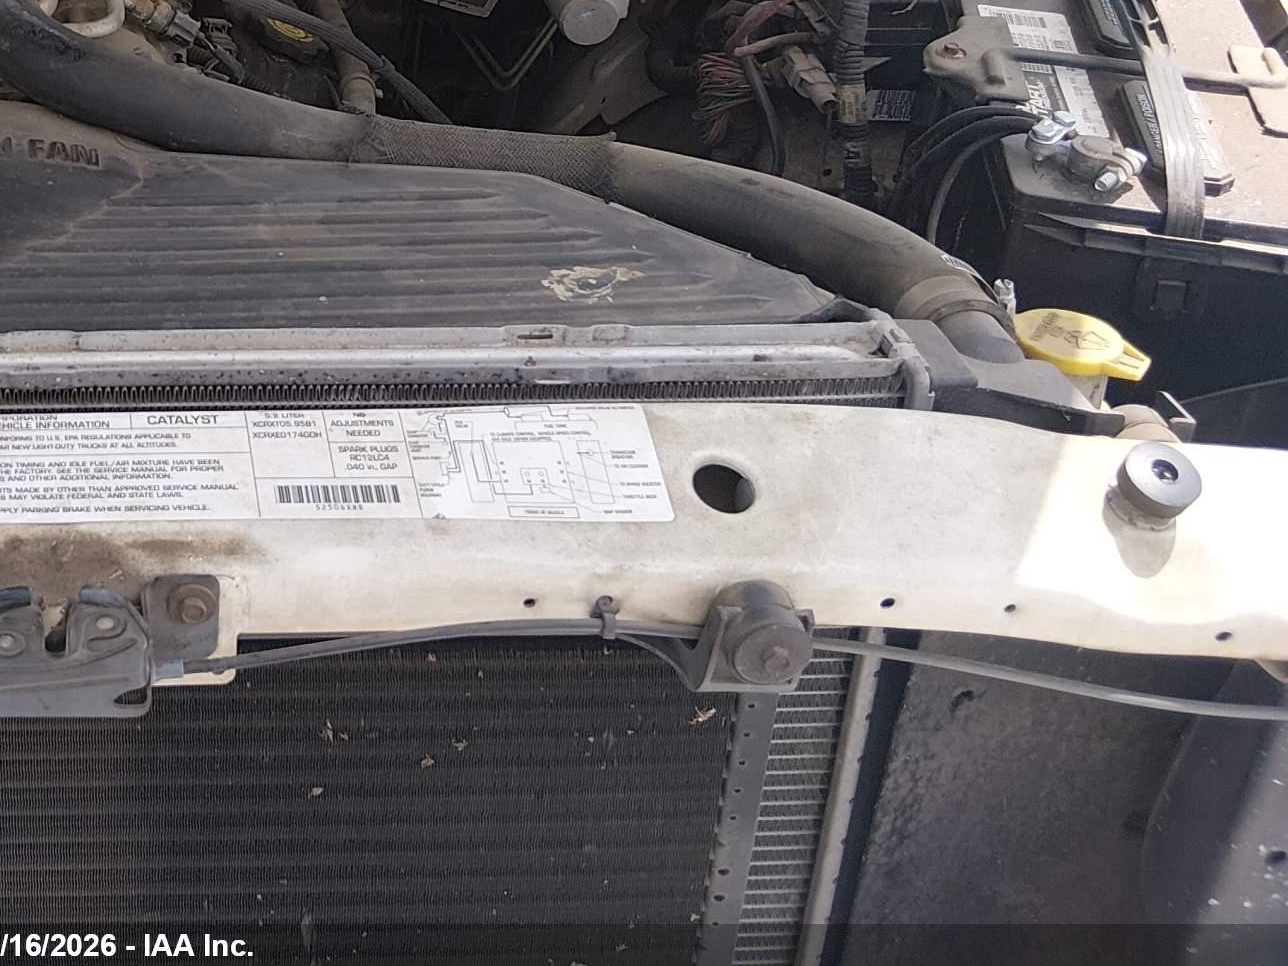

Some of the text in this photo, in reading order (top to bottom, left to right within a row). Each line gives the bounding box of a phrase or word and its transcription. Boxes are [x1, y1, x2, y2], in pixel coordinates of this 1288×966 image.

[27, 138, 100, 167] FAN
[147, 415, 220, 425] CATALYST
[34, 421, 111, 429] INFORMATION
[338, 445, 367, 453] SPARK
